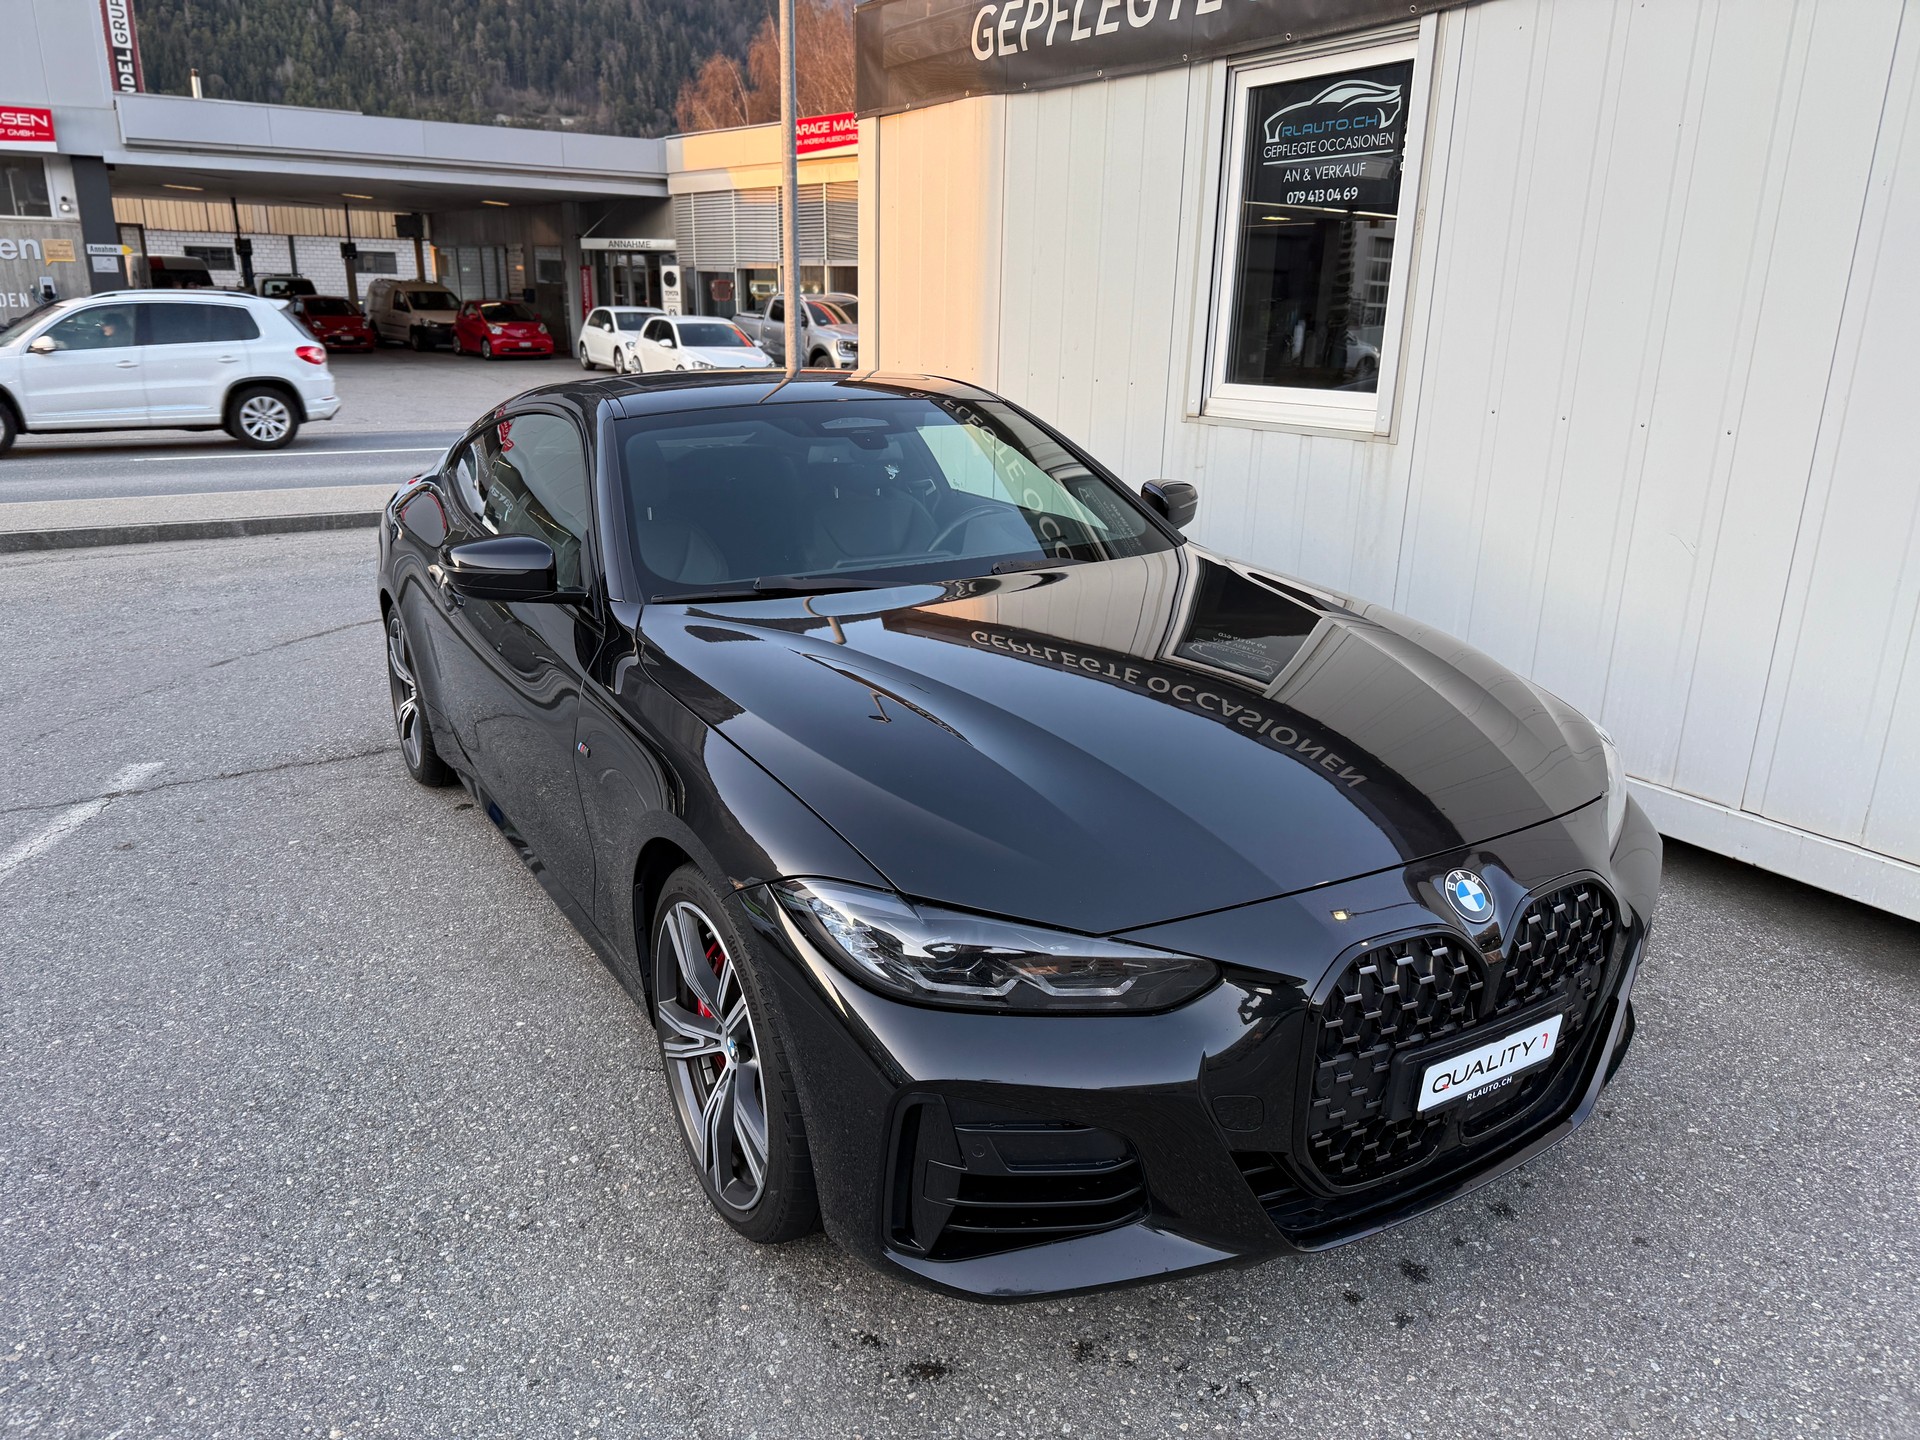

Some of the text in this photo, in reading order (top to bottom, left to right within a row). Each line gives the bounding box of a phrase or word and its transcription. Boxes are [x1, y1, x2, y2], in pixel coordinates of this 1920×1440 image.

[0, 112, 49, 128] SEN
[1281, 115, 1379, 138] RLAUTO.CH
[1263, 131, 1395, 159] GEPFLEGTE OCCASIONEN
[1283, 162, 1367, 183] AN & VERKAUF
[1286, 186, 1359, 205] 079 413 04 69
[89, 245, 118, 254] Annahme
[608, 240, 652, 249] ANNAHME
[1447, 871, 1480, 892] BMW
[1432, 1036, 1538, 1094] QUALITY
[1466, 1076, 1513, 1101] RLAUTO.CH
